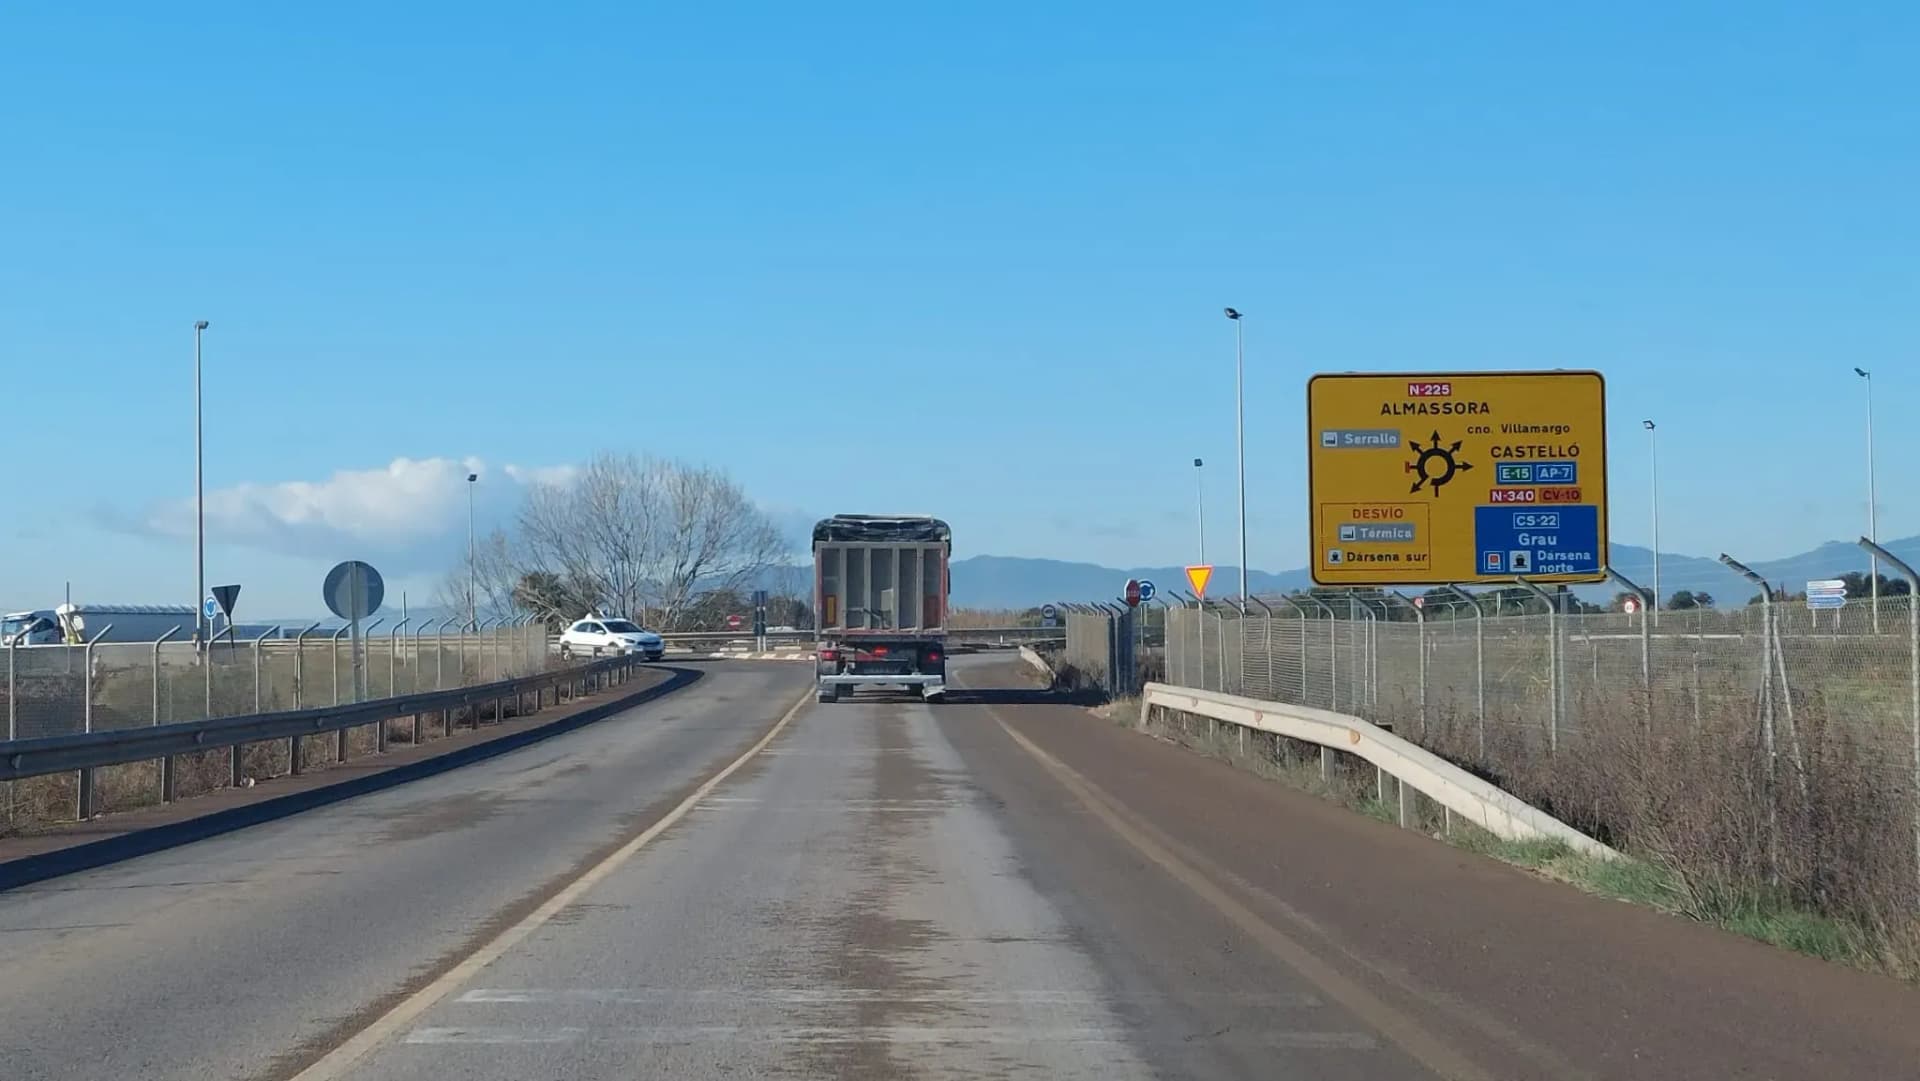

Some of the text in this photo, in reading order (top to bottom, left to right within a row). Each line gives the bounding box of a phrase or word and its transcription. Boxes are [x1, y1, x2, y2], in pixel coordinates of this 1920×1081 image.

[1409, 385, 1450, 395] N-225
[1381, 402, 1490, 415] ALMASSORA
[1501, 424, 1570, 435] Villamargo
[1344, 433, 1397, 444] Serrallo
[1490, 442, 1580, 458] CASTELLÓ
[1502, 468, 1530, 479] E-15
[1540, 467, 1570, 478] AP-7
[1491, 490, 1534, 502] N-340
[1543, 490, 1580, 500] CV-10
[1516, 515, 1557, 526] CS-22
[1518, 533, 1557, 546] Grau
[1346, 552, 1427, 562] Dársena sur
[1538, 549, 1591, 561] Dársena
[1539, 563, 1574, 573] norte
